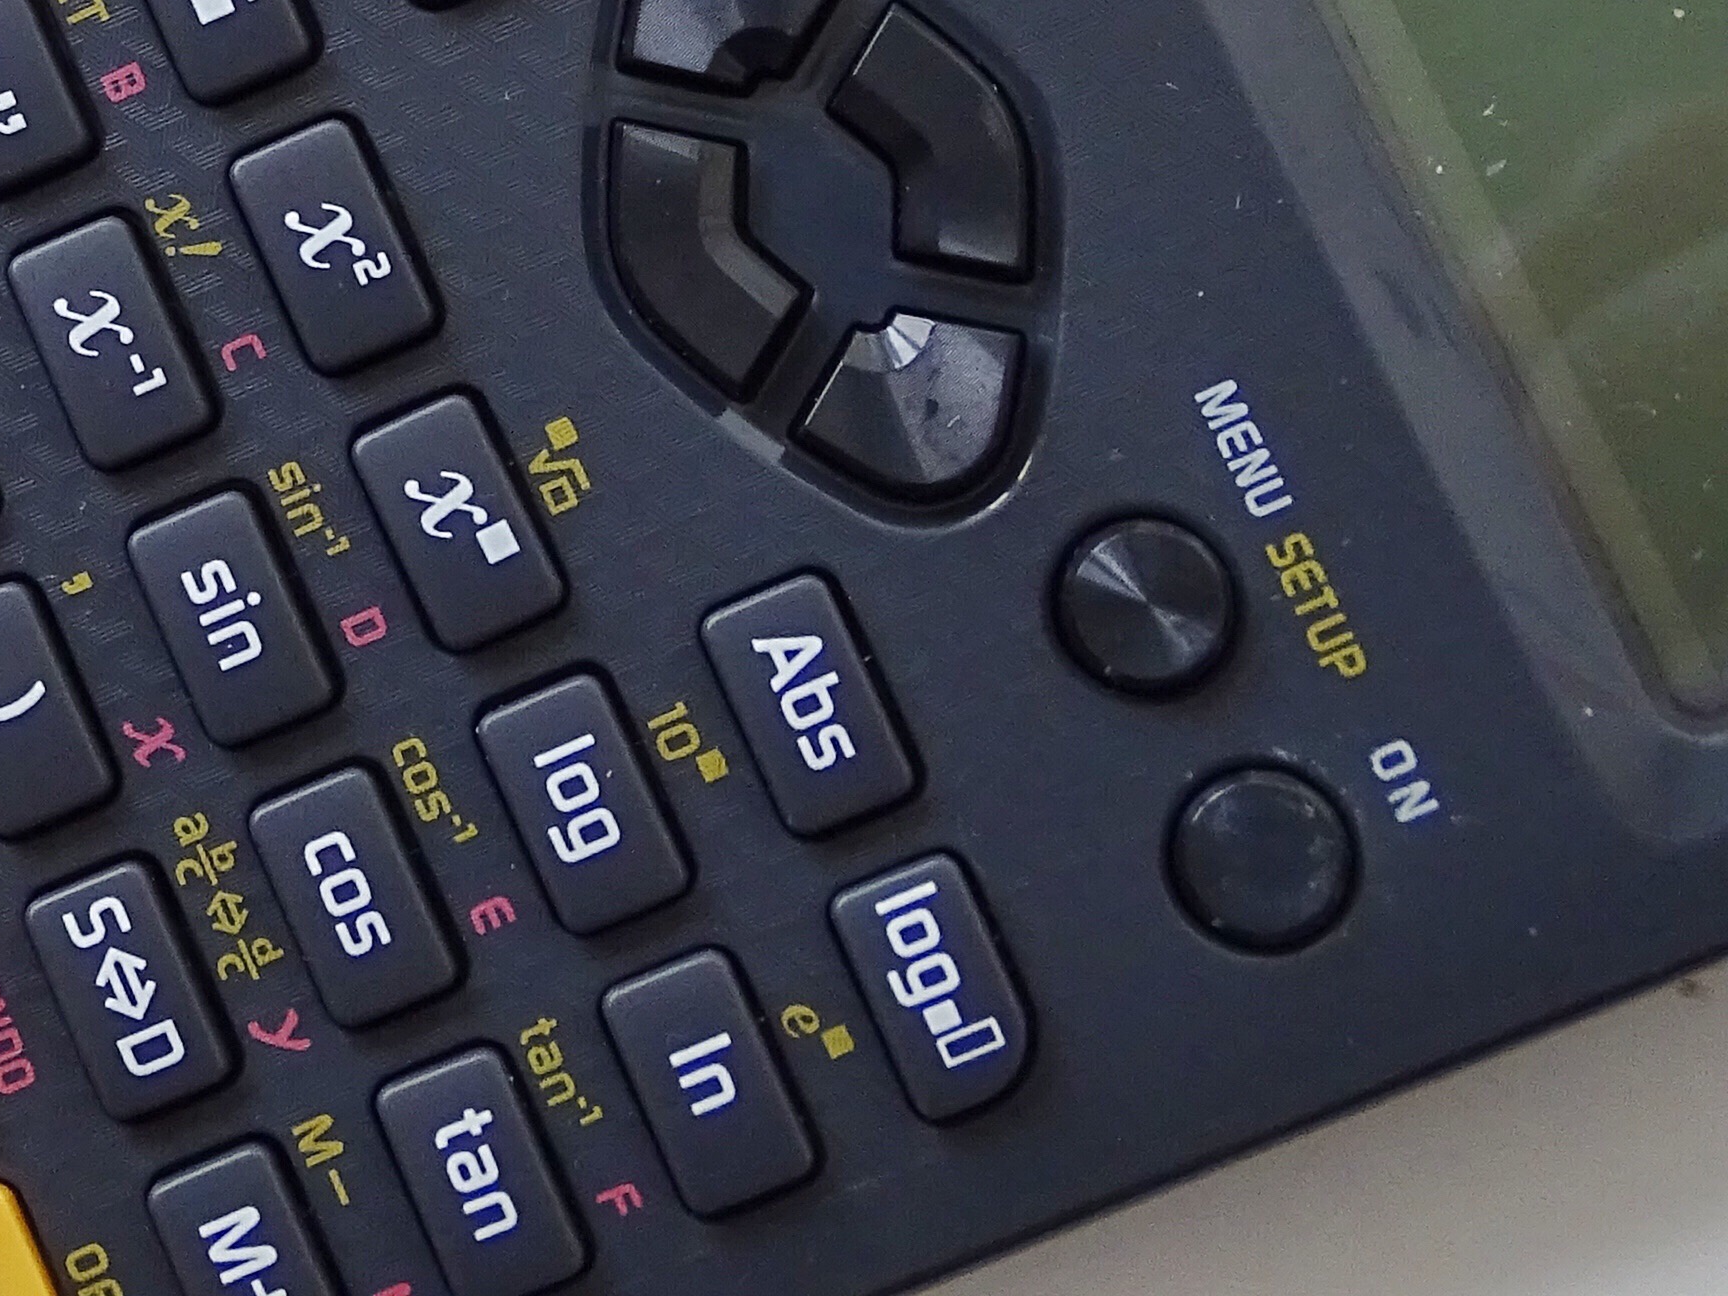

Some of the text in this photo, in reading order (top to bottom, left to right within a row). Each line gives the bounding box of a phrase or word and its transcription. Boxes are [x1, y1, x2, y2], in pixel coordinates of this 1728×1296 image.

[98, 60, 147, 104] B
[221, 332, 267, 373] C
[1194, 378, 1369, 680] MENU SETUP
[180, 557, 264, 672] sin
[340, 605, 387, 647] D
[749, 633, 857, 772] Abs
[532, 732, 622, 865] log
[1368, 738, 1440, 824] ON
[302, 831, 393, 958] cos
[470, 895, 517, 936] E
[668, 1031, 738, 1117] ln
[434, 1106, 520, 1243] tan
[595, 1181, 644, 1217] F
